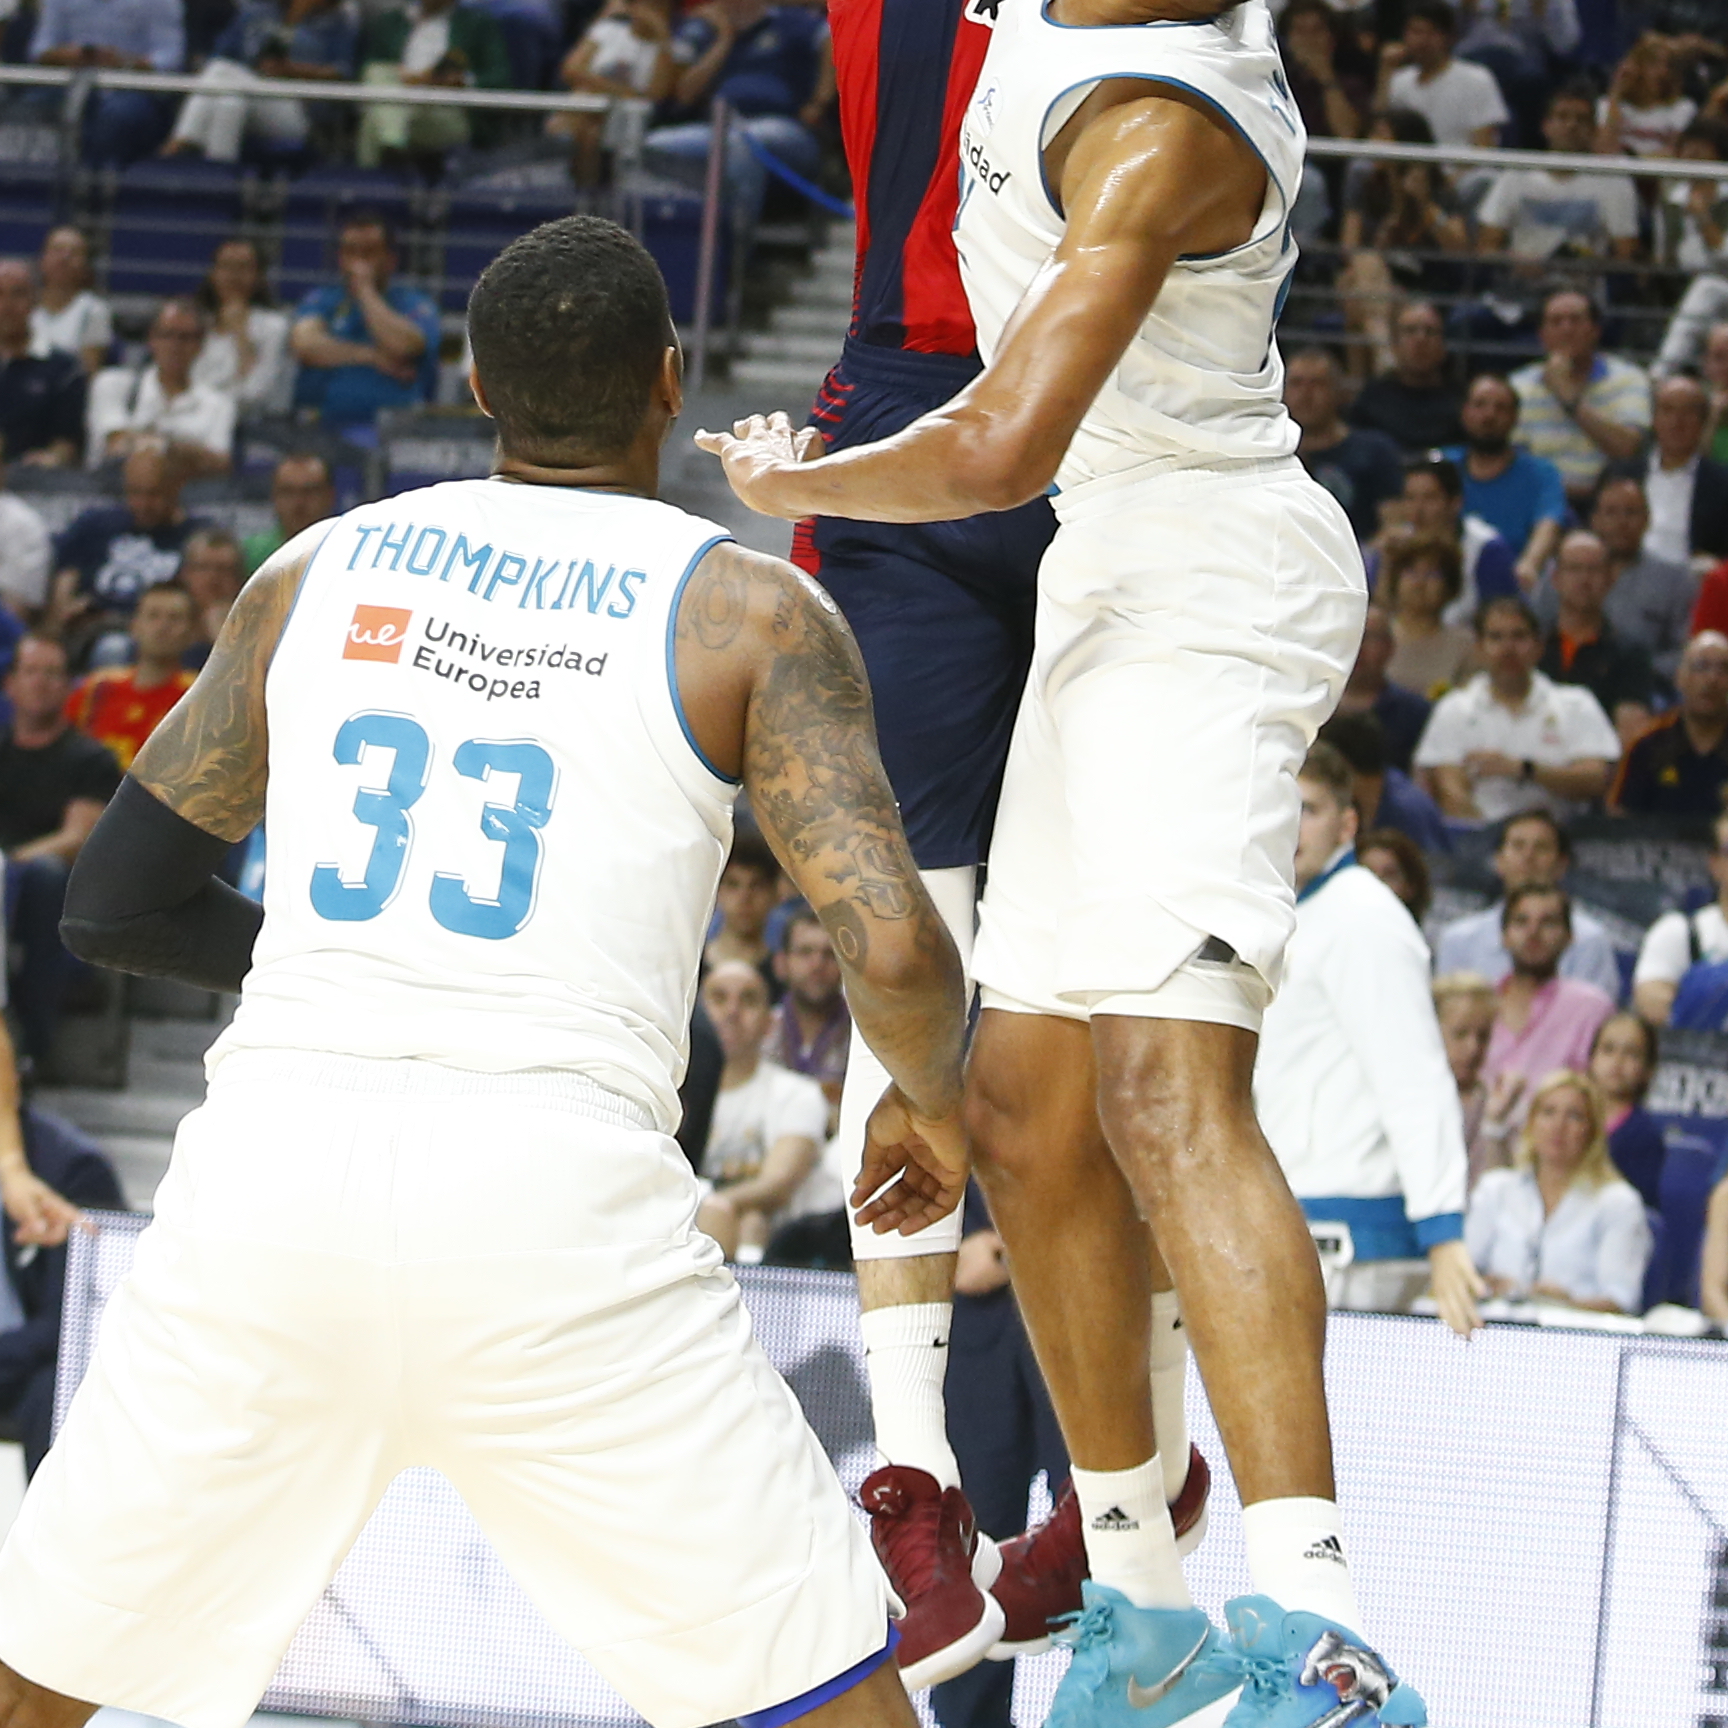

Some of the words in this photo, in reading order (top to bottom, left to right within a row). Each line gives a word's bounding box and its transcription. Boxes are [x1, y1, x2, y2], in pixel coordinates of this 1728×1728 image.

[346, 521, 647, 620] THOMPKINS
[412, 645, 541, 702] Europea
[423, 616, 608, 677] Universidad
[309, 708, 561, 940] 33
